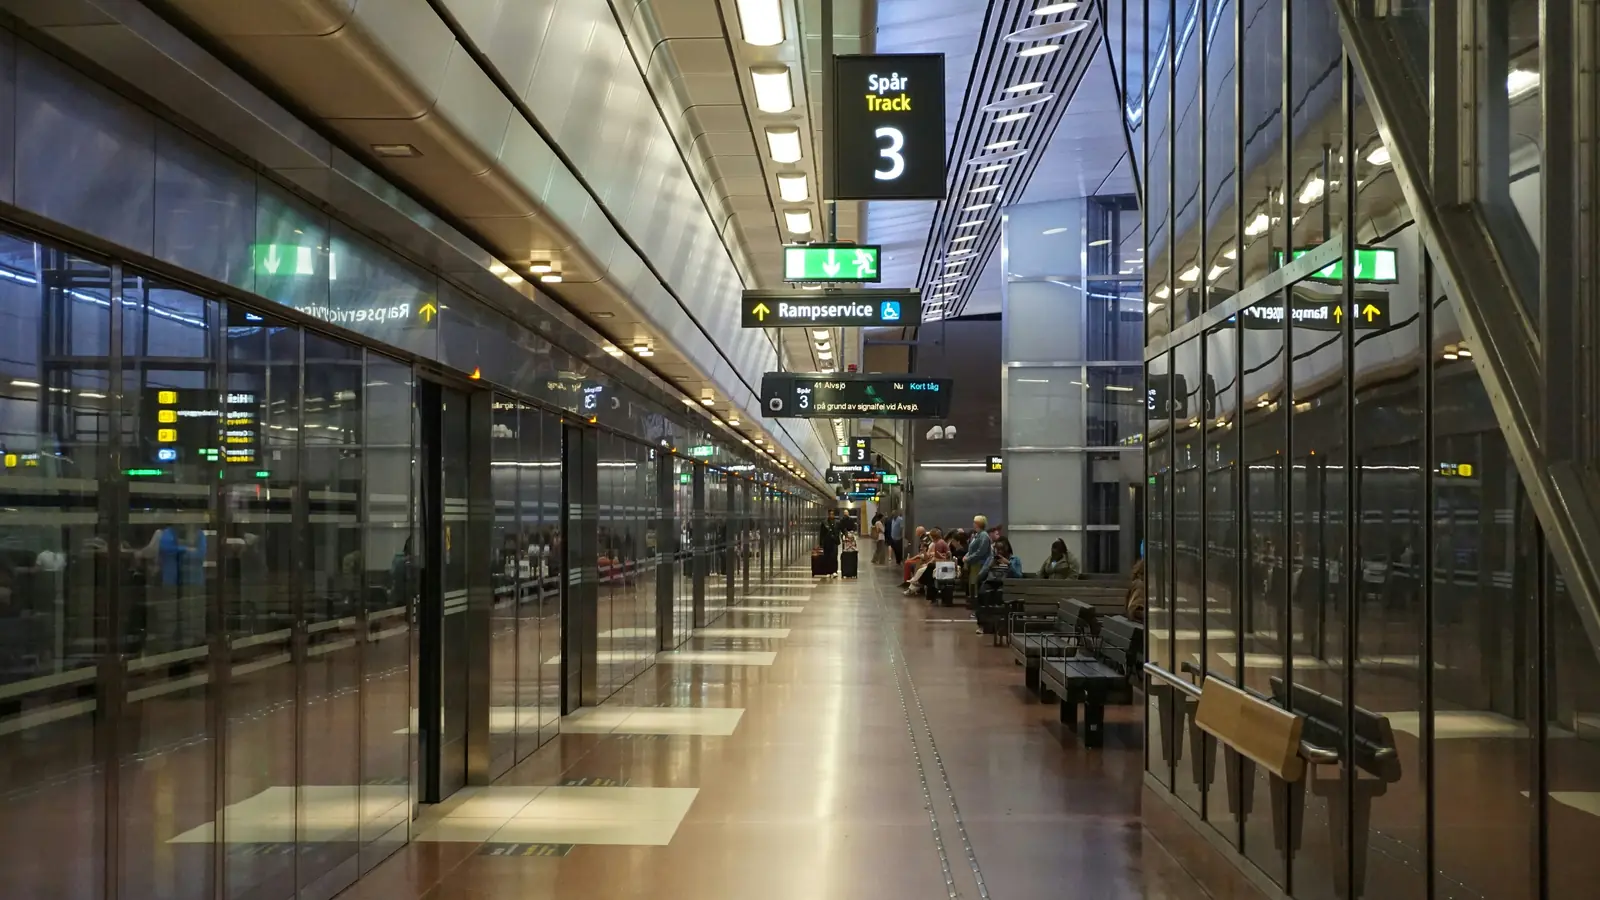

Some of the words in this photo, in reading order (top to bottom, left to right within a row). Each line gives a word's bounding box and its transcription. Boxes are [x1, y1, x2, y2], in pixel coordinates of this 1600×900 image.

[868, 72, 908, 95] Spår
[865, 93, 912, 112] Track
[873, 127, 905, 181] 3
[778, 301, 873, 321] Rampservice
[796, 387, 811, 395] Spår
[893, 382, 904, 390] Nu
[910, 382, 926, 390] Kort
[799, 395, 809, 409] 3
[817, 401, 826, 411] på
[827, 403, 847, 412] grund
[857, 449, 865, 460] 3
